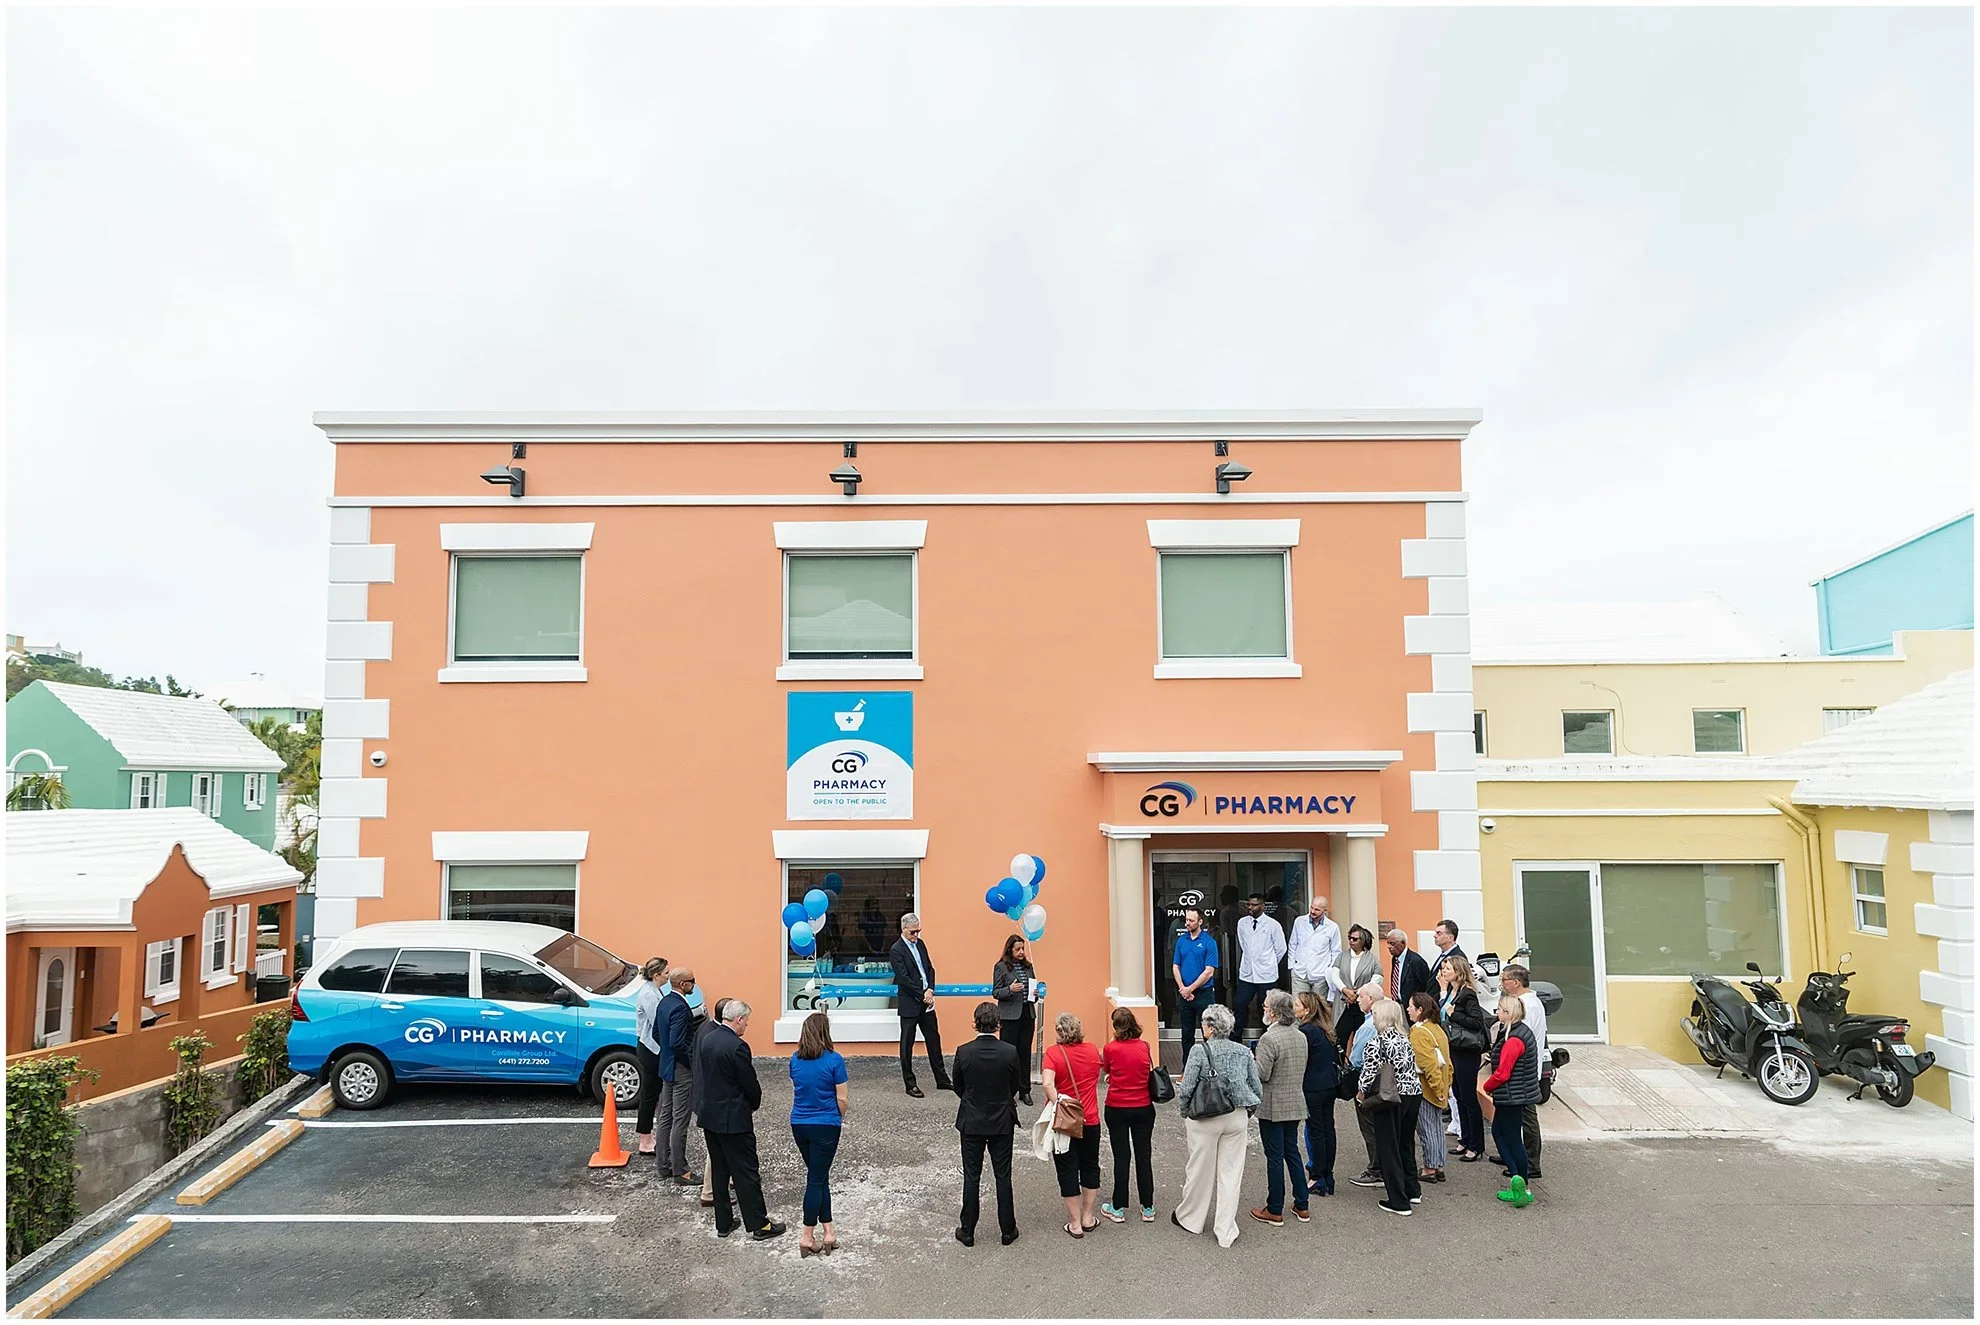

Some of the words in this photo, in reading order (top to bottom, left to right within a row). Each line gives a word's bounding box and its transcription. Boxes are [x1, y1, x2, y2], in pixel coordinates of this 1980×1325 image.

[832, 759, 857, 773] CG
[813, 780, 886, 789] PHARMACY
[1140, 794, 1180, 817] CG
[1215, 795, 1356, 815] PHARMACY
[1179, 895, 1197, 906] CG
[1167, 909, 1216, 917] PHACY
[405, 1027, 434, 1043] CG
[460, 1029, 567, 1043] PHARMACY
